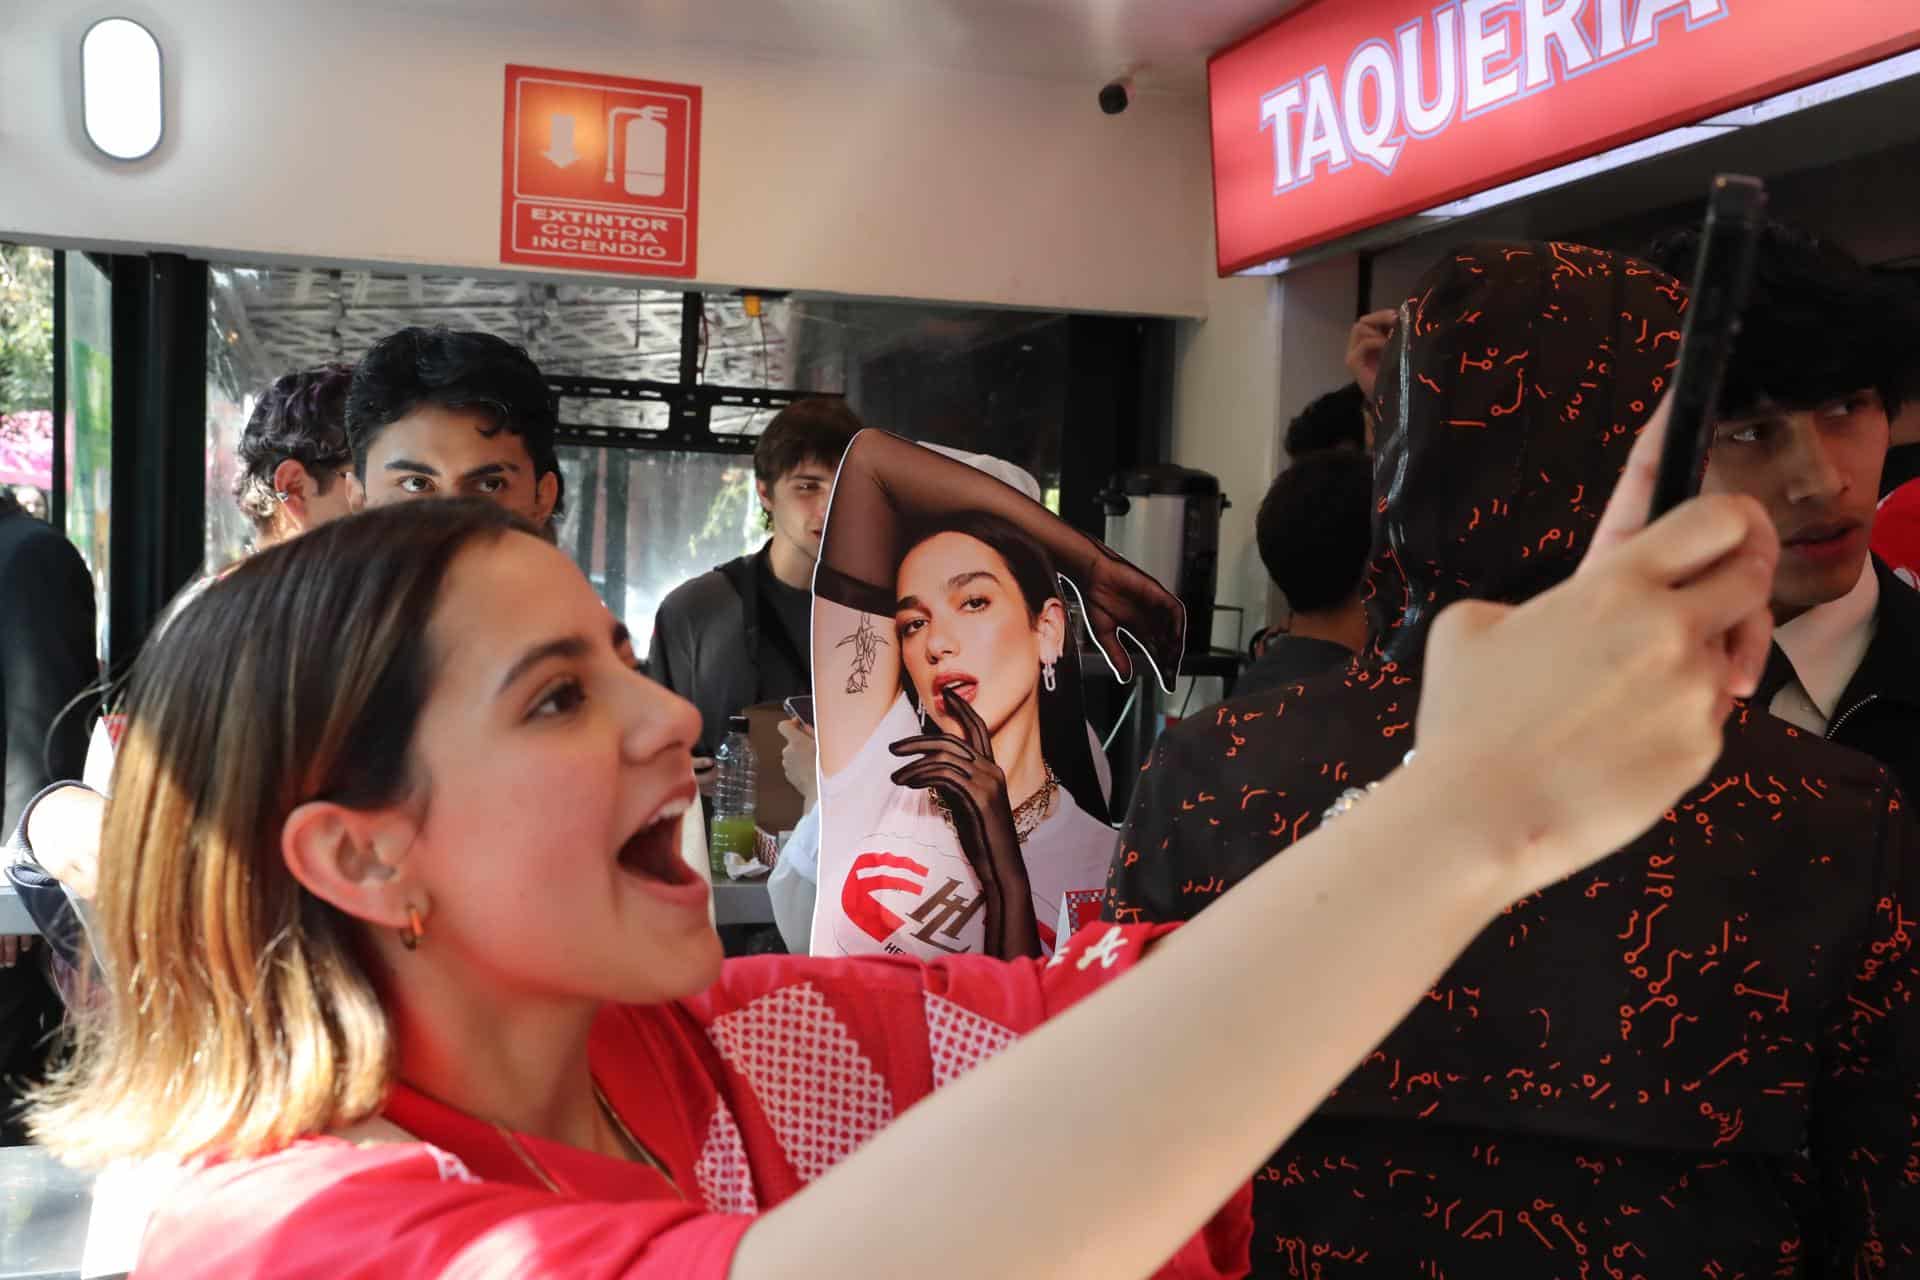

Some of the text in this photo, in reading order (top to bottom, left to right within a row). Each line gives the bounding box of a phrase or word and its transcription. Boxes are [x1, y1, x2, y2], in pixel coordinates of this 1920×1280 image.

[1260, 0, 1728, 194] TAQUER
[530, 207, 669, 232] EXTINTOR
[540, 223, 659, 244] CONTRA
[531, 235, 667, 258] INCENDIO
